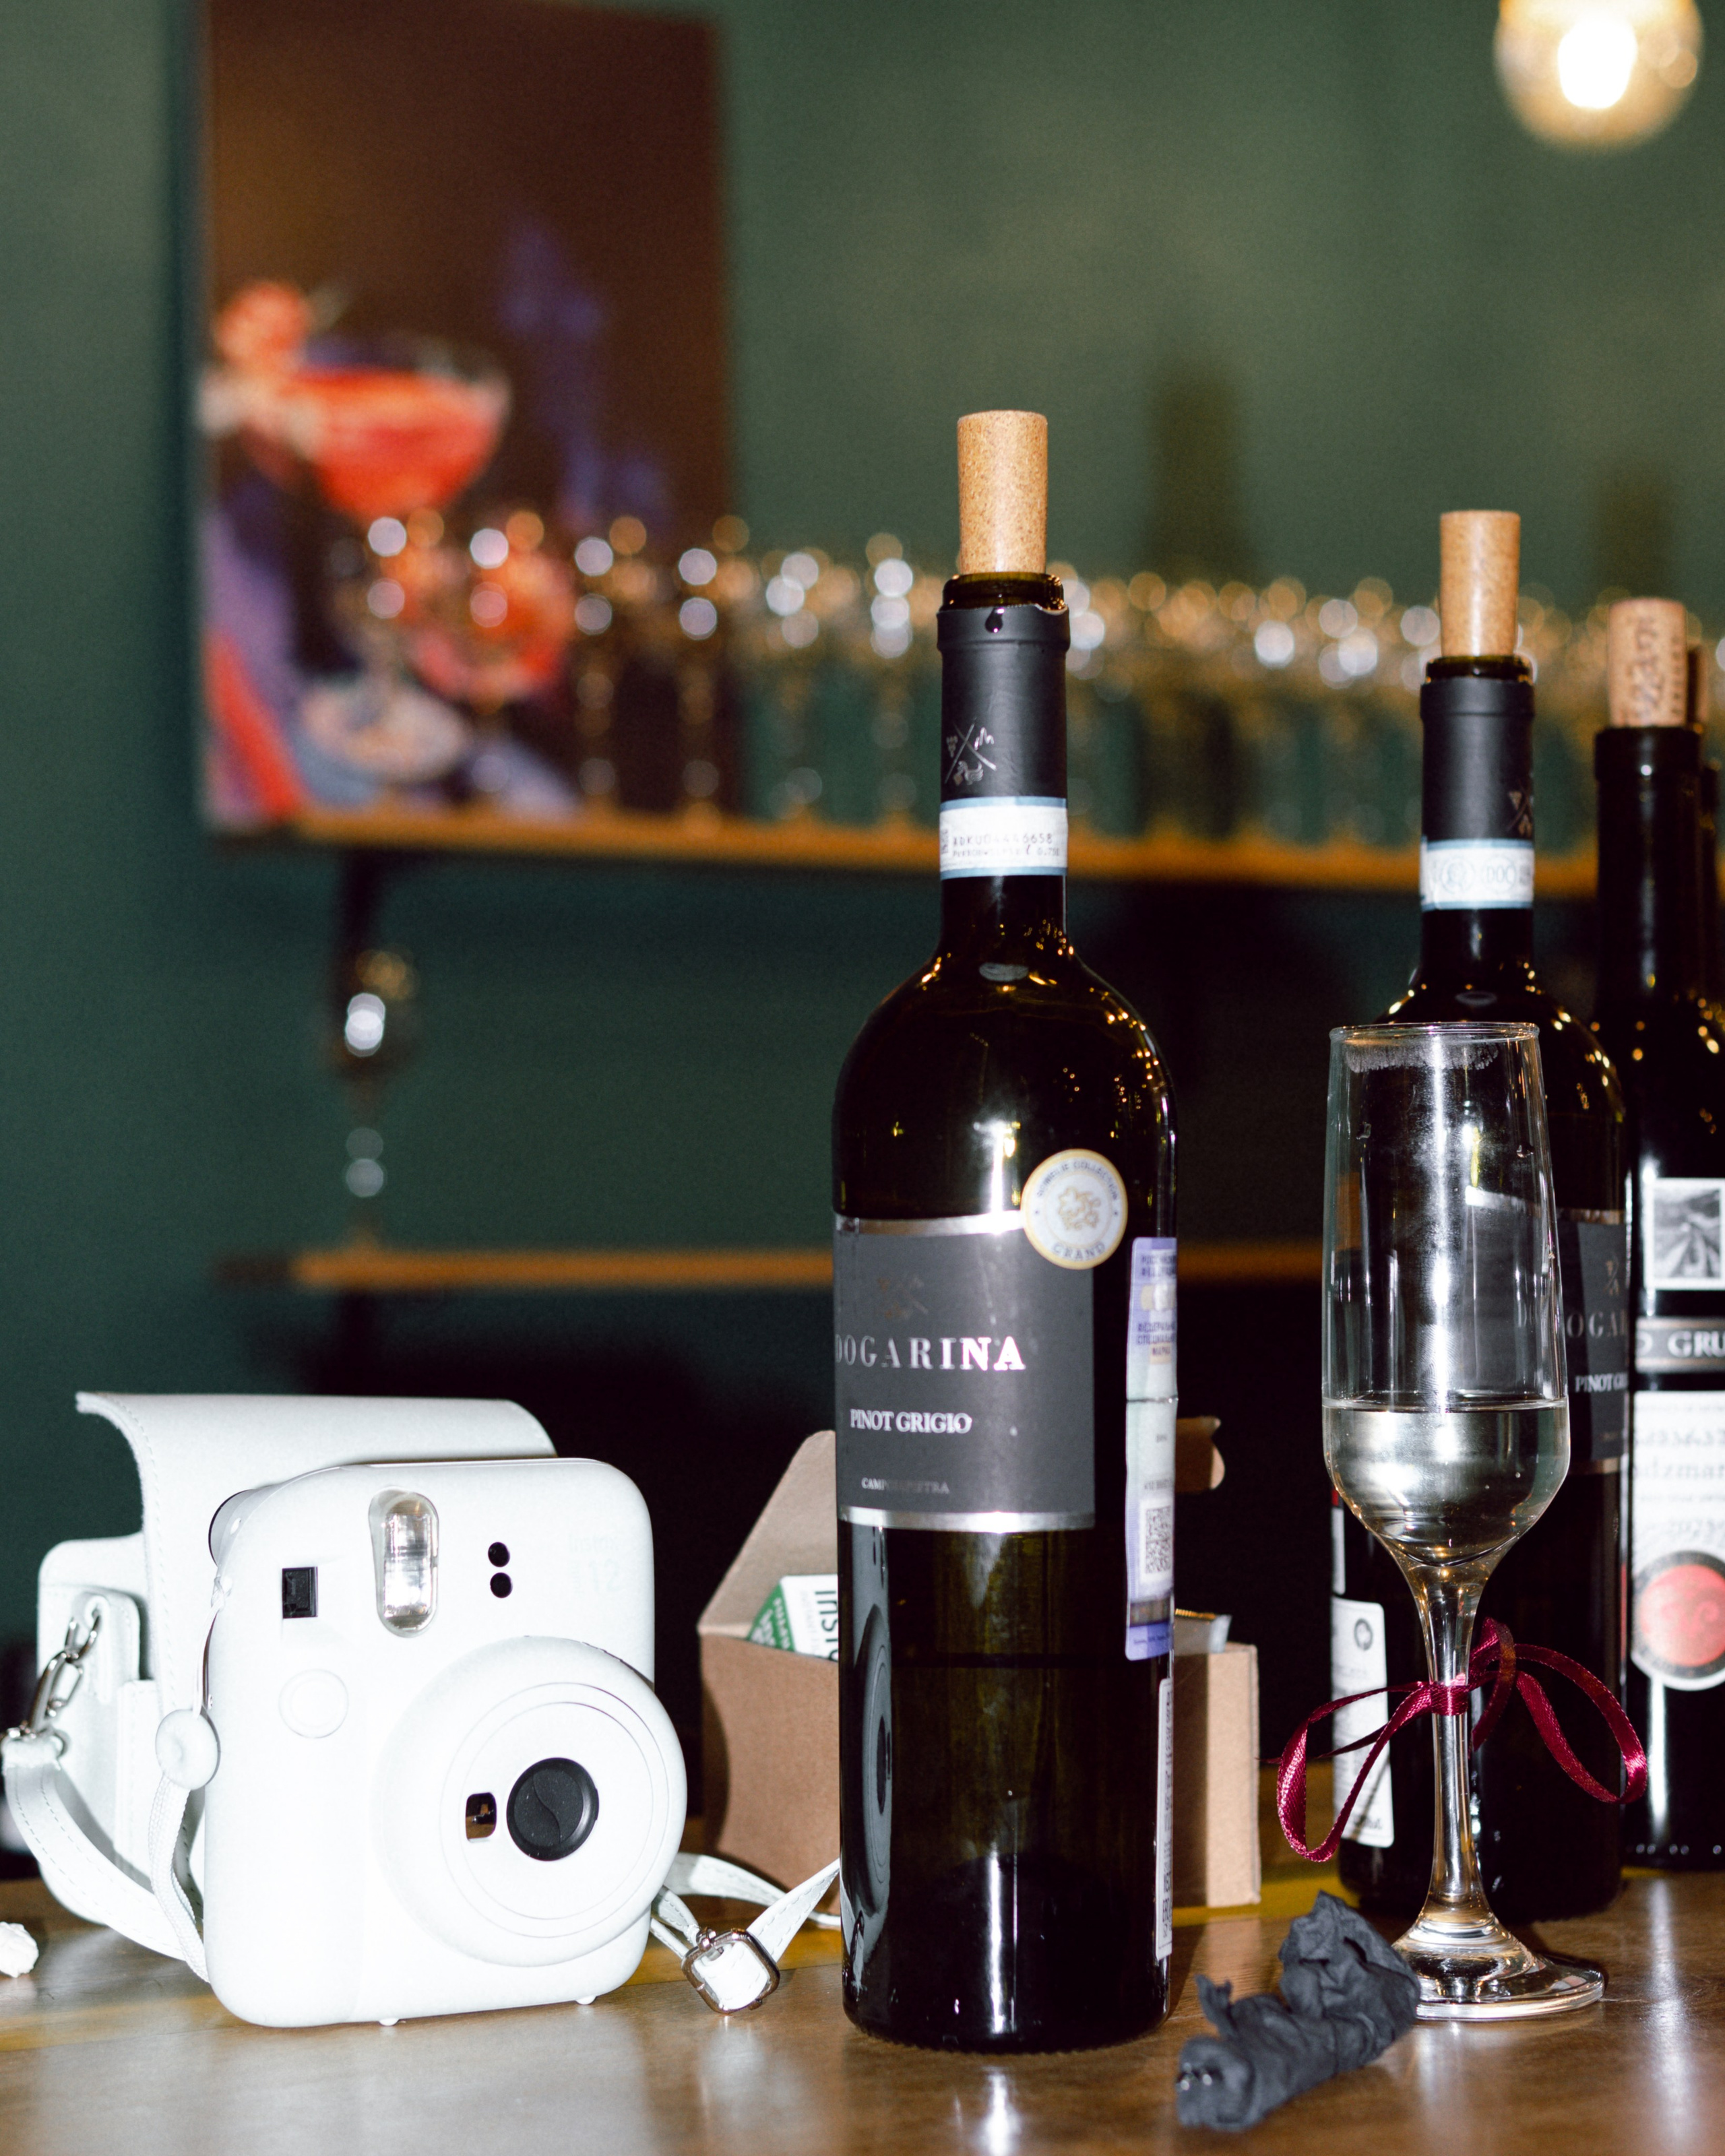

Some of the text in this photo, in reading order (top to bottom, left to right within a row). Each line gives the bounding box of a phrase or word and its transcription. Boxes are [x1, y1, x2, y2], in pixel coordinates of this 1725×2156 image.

[1053, 1241, 1106, 1261] GRAND
[1575, 1375, 1612, 1393] PINOT
[850, 1409, 972, 1434] PINOT GRIGIO
